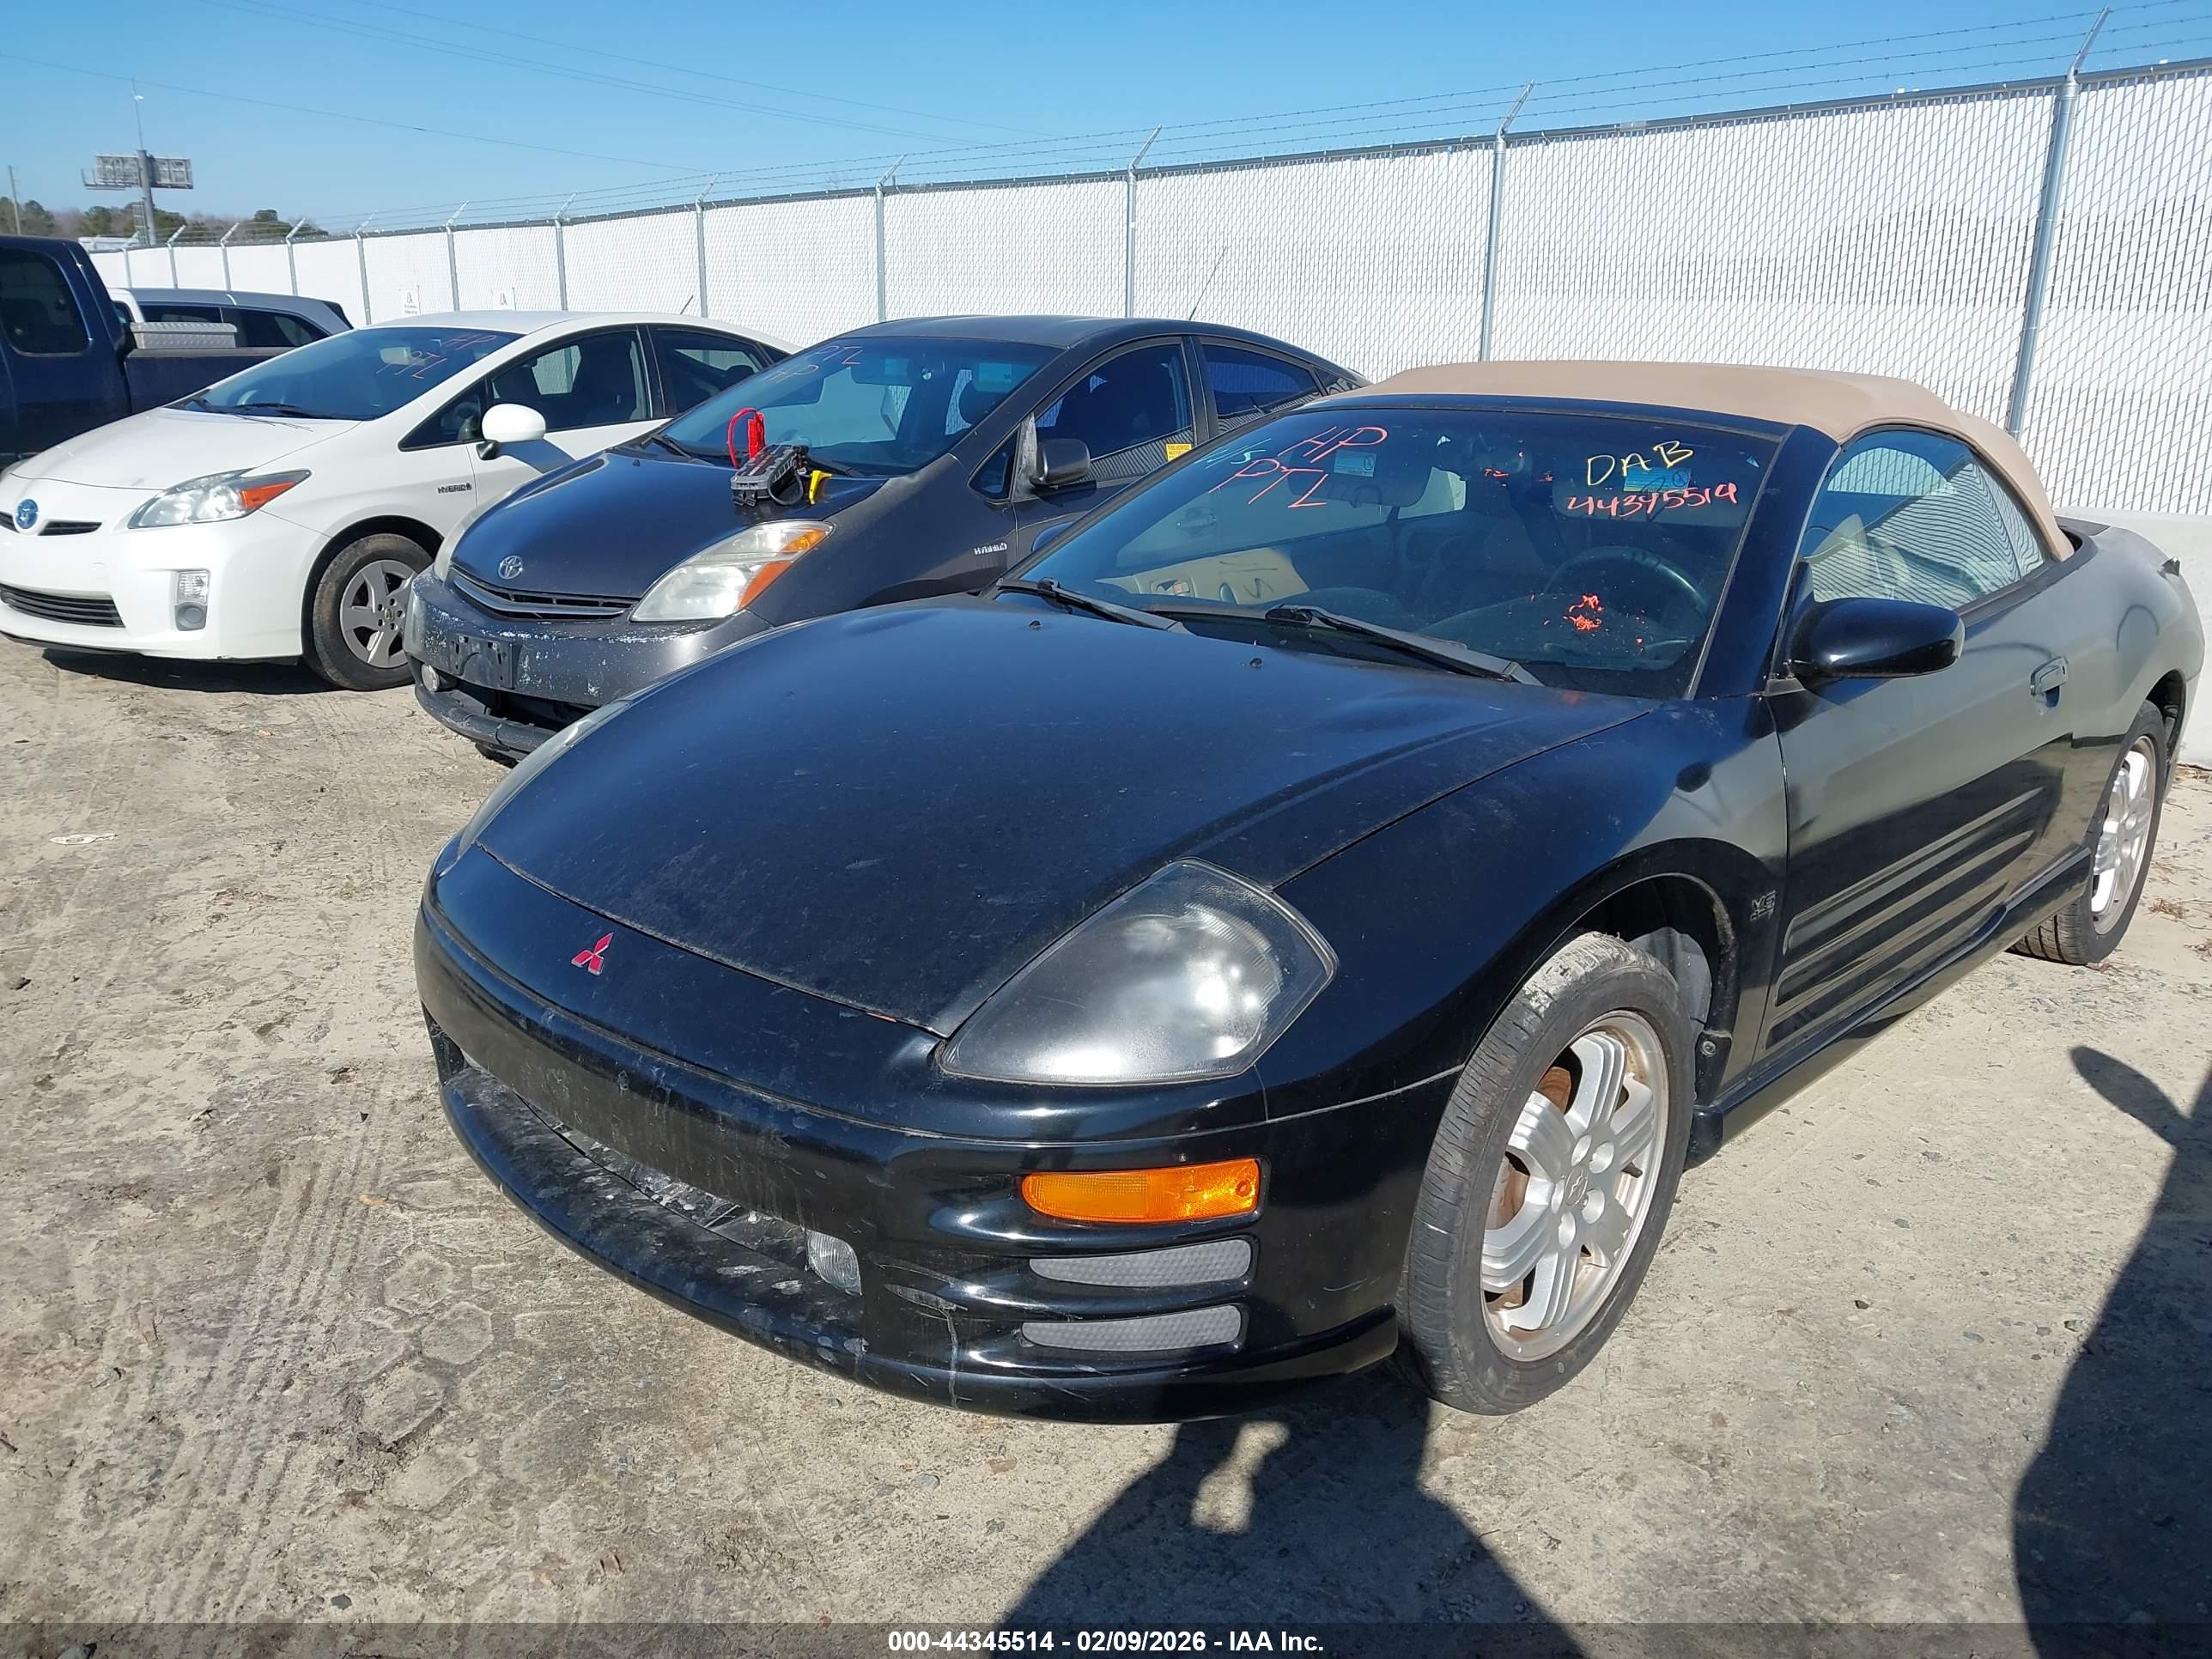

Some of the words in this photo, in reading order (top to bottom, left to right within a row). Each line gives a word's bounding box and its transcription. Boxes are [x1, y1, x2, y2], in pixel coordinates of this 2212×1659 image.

[1277, 427, 1388, 463] HP
[1587, 441, 1693, 486] DAB
[1209, 459, 1328, 507] PTL
